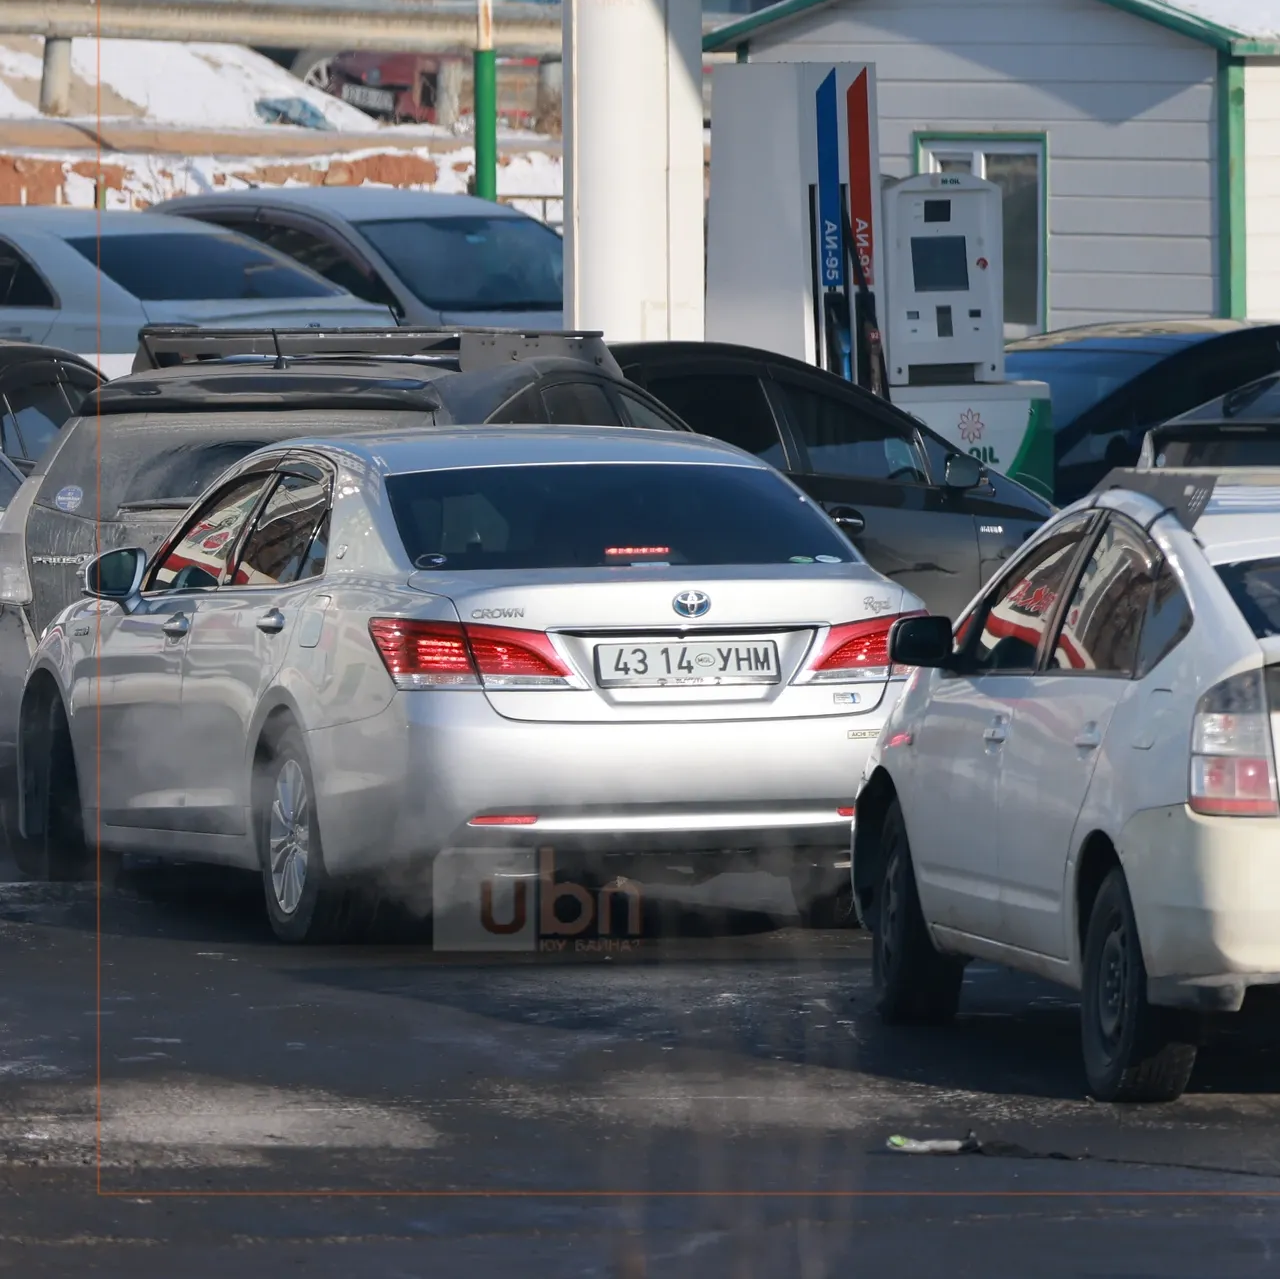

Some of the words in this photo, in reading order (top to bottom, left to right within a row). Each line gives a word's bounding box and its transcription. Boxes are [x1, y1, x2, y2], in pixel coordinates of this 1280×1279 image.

[825, 220, 839, 280] АИ-95
[471, 607, 525, 620] CROWN
[614, 648, 648, 675] 43
[660, 646, 694, 674] 14
[717, 647, 771, 672] УНМ
